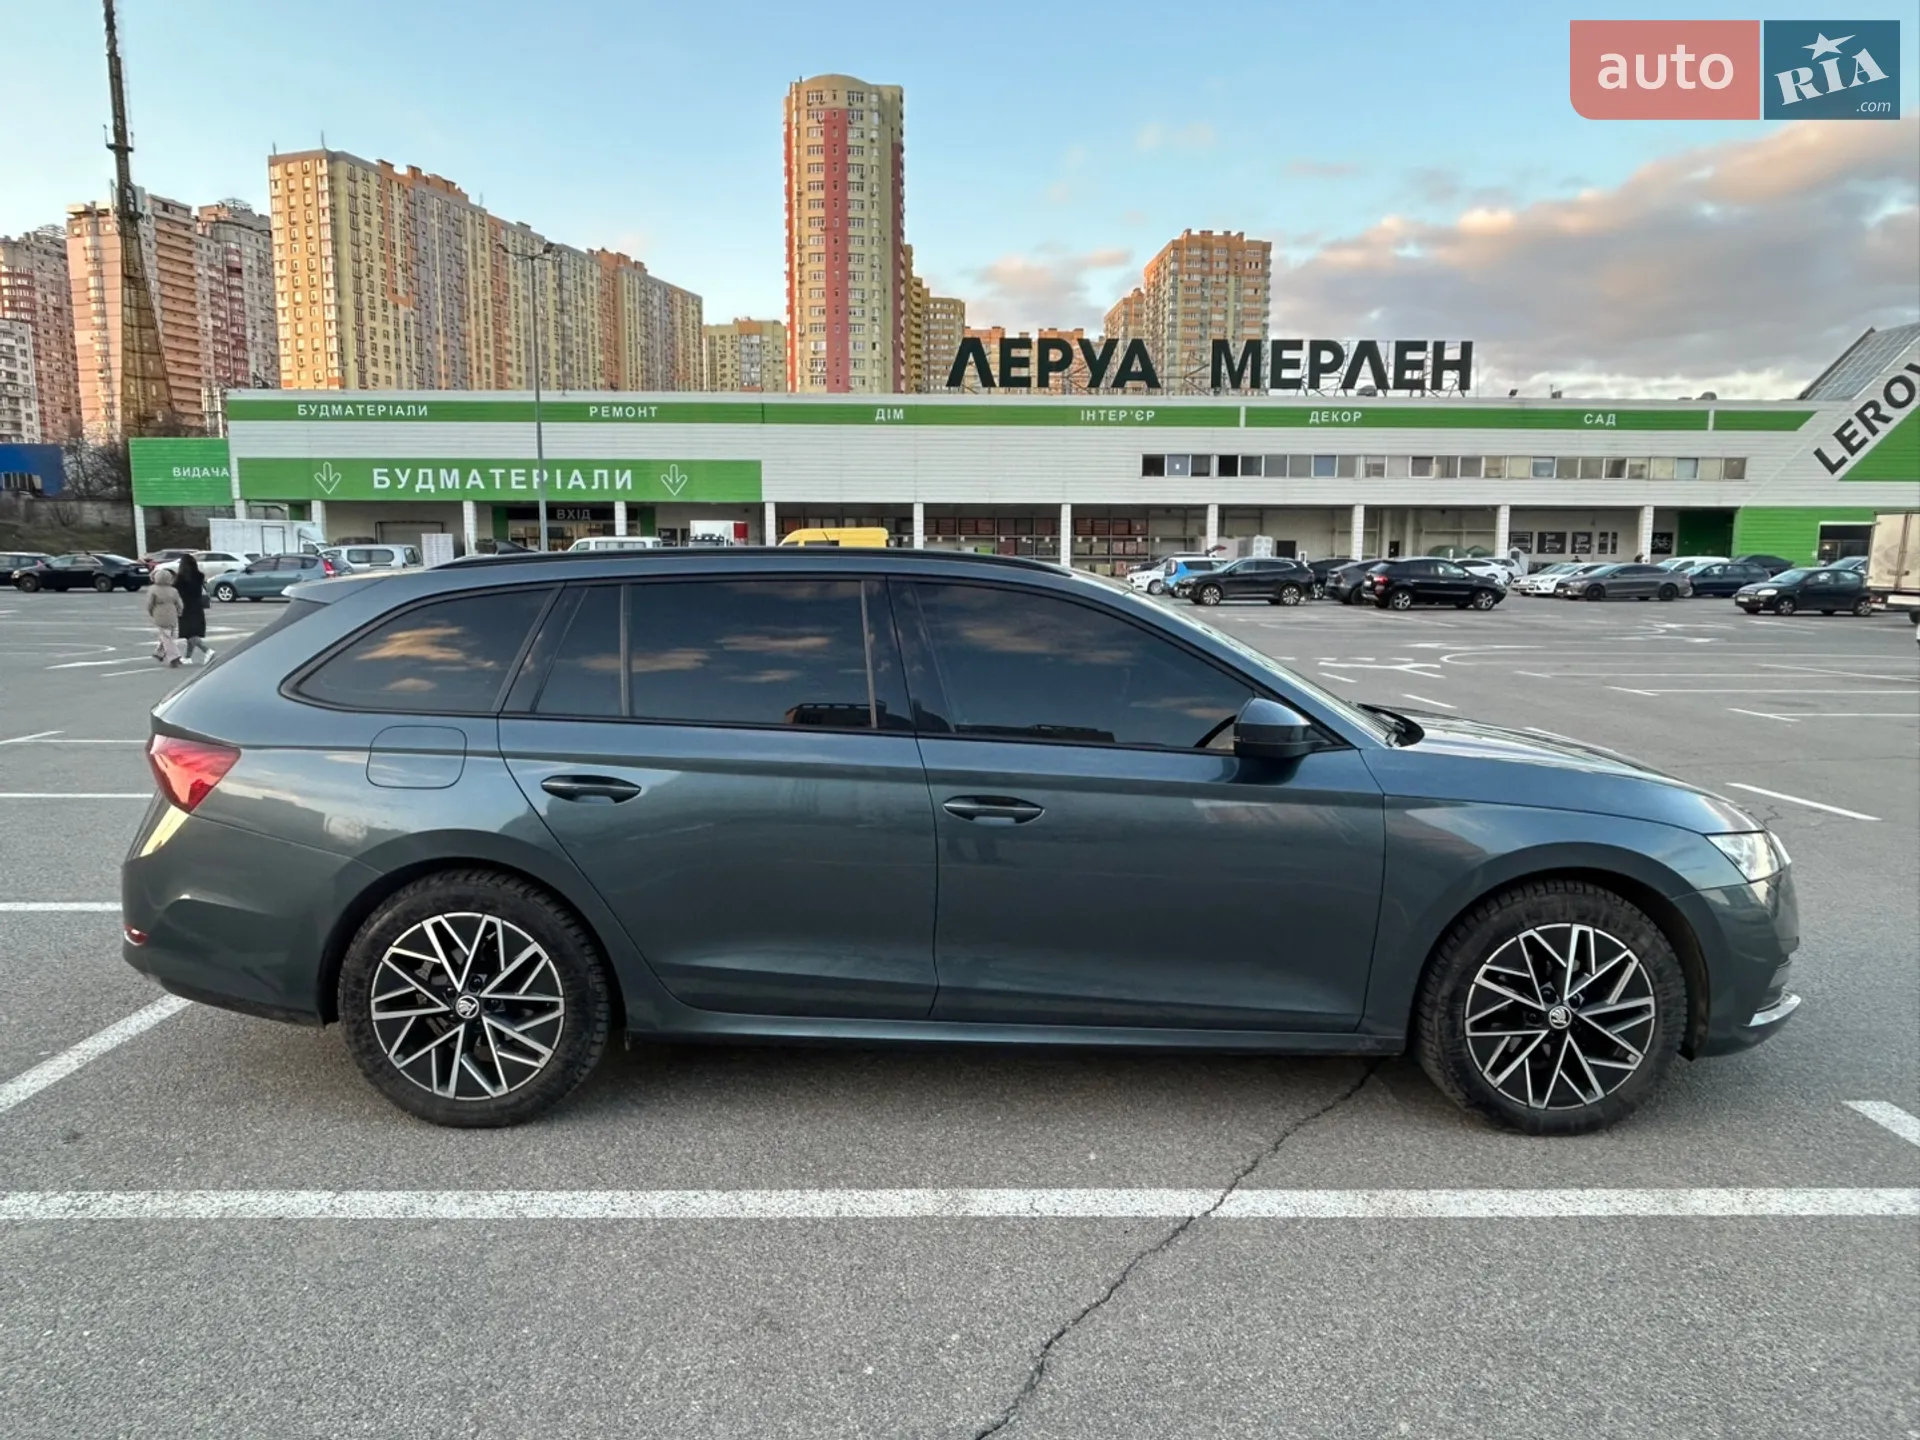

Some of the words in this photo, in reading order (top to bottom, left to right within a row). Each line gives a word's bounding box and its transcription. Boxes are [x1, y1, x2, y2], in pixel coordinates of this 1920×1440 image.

[946, 337, 1161, 388] ЛЕРУА
[1210, 339, 1474, 391] МЕРЛЕН
[297, 403, 429, 418] БУДМАТЕРІАЛИ
[588, 405, 658, 418] РЕМОНТ
[875, 408, 905, 421] ДІМ
[1309, 410, 1363, 424] ДЕКОР
[1584, 413, 1617, 427] САД
[173, 466, 229, 478] ВИДАЧА
[372, 467, 633, 493] БУДМАТЕРІАЛИ
[556, 509, 591, 521] ВХІД
